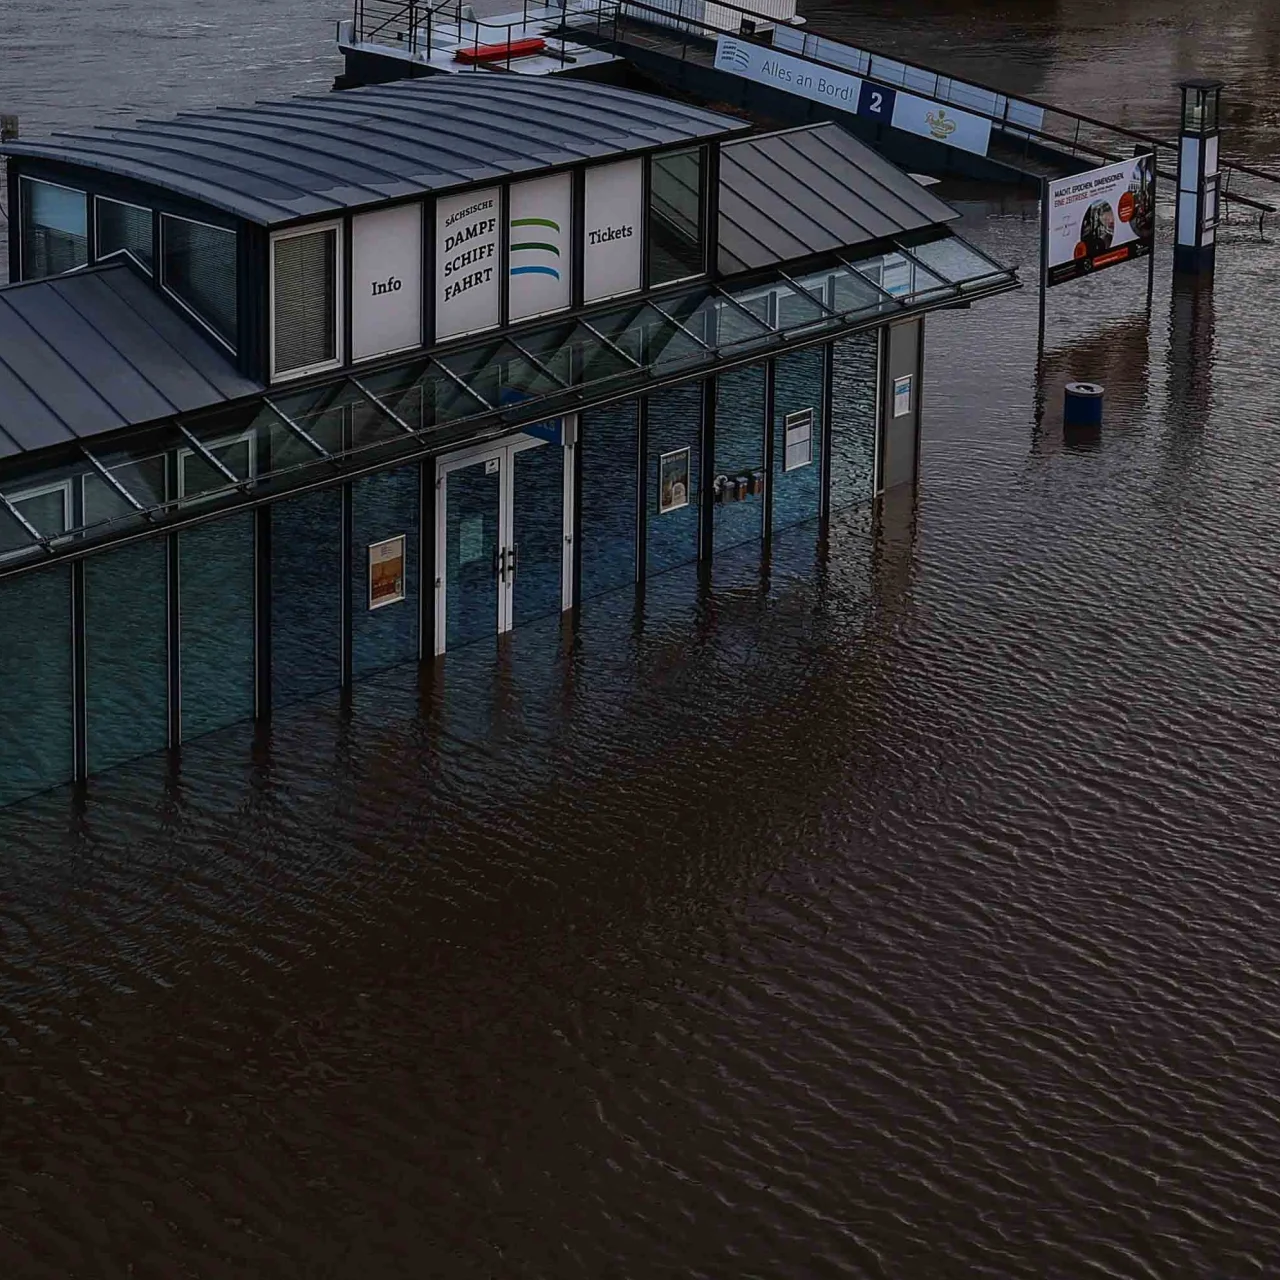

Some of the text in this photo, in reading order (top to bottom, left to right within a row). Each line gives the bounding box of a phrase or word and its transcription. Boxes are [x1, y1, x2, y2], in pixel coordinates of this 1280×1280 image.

[761, 59, 854, 103] Alles an Bord!
[869, 92, 883, 113] 2
[445, 199, 494, 227] SÄCHSISCHE
[444, 218, 496, 252] DAMPF
[588, 225, 633, 244] Tickets
[444, 243, 495, 277] SCHIFF
[371, 276, 402, 296] Info
[444, 267, 493, 302] FAHRT
